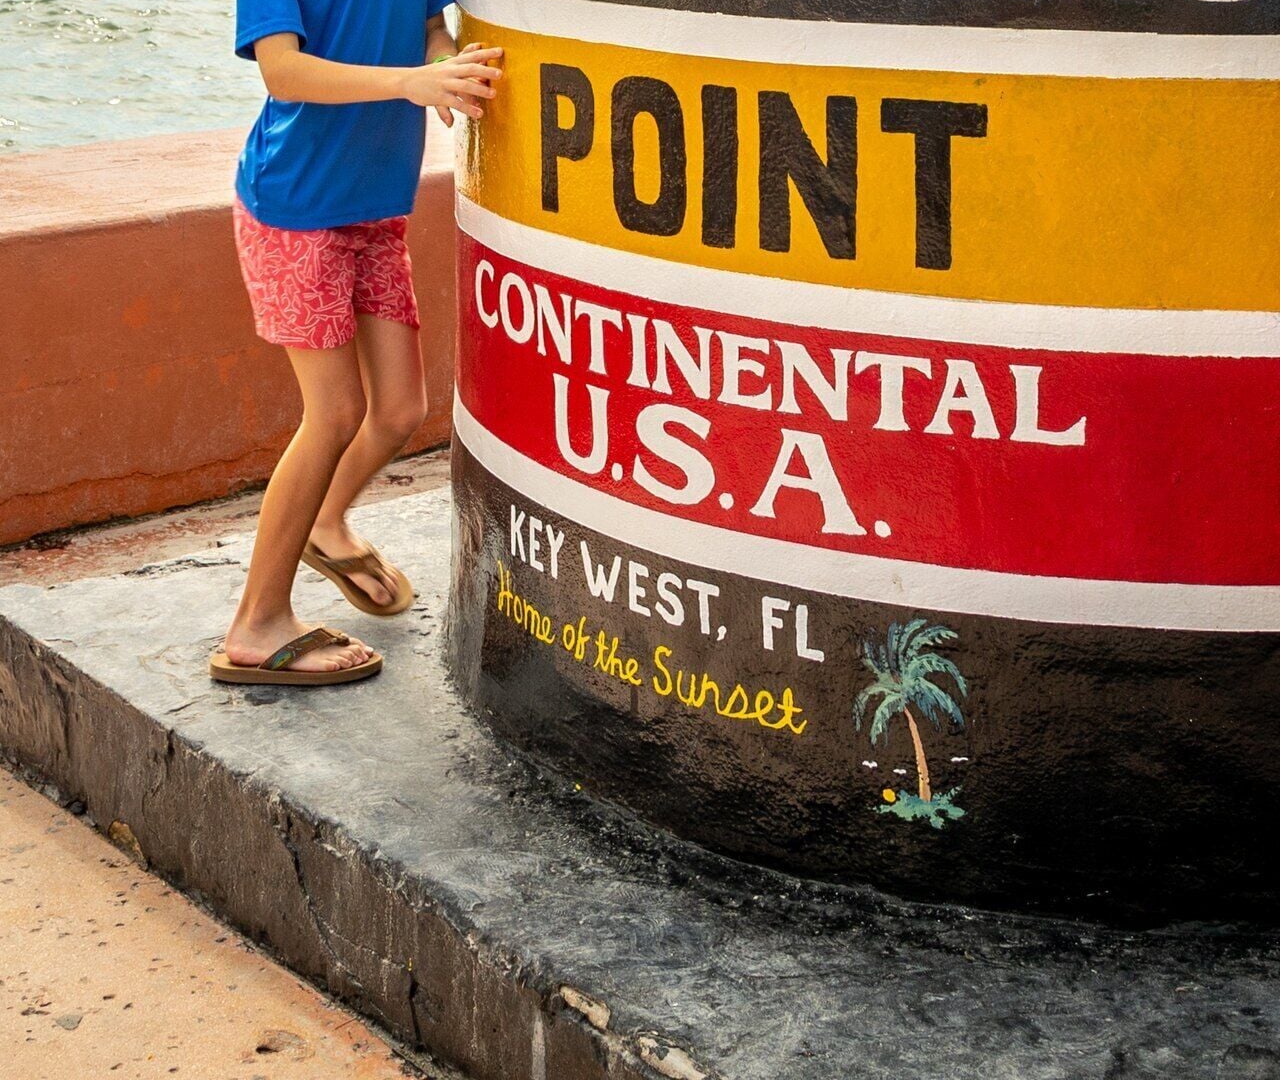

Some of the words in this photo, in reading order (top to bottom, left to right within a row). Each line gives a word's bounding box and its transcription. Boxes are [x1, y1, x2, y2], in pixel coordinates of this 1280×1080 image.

[540, 63, 988, 271] POINT
[475, 259, 1086, 446] CONTINENTAL
[553, 372, 891, 538] U.S.A.
[497, 560, 555, 644] Home
[563, 616, 591, 661] of
[593, 630, 642, 686] the
[652, 646, 807, 734] Sunset
[510, 504, 565, 580] KEY
[580, 540, 727, 641] WEST,
[761, 596, 825, 663] FL
